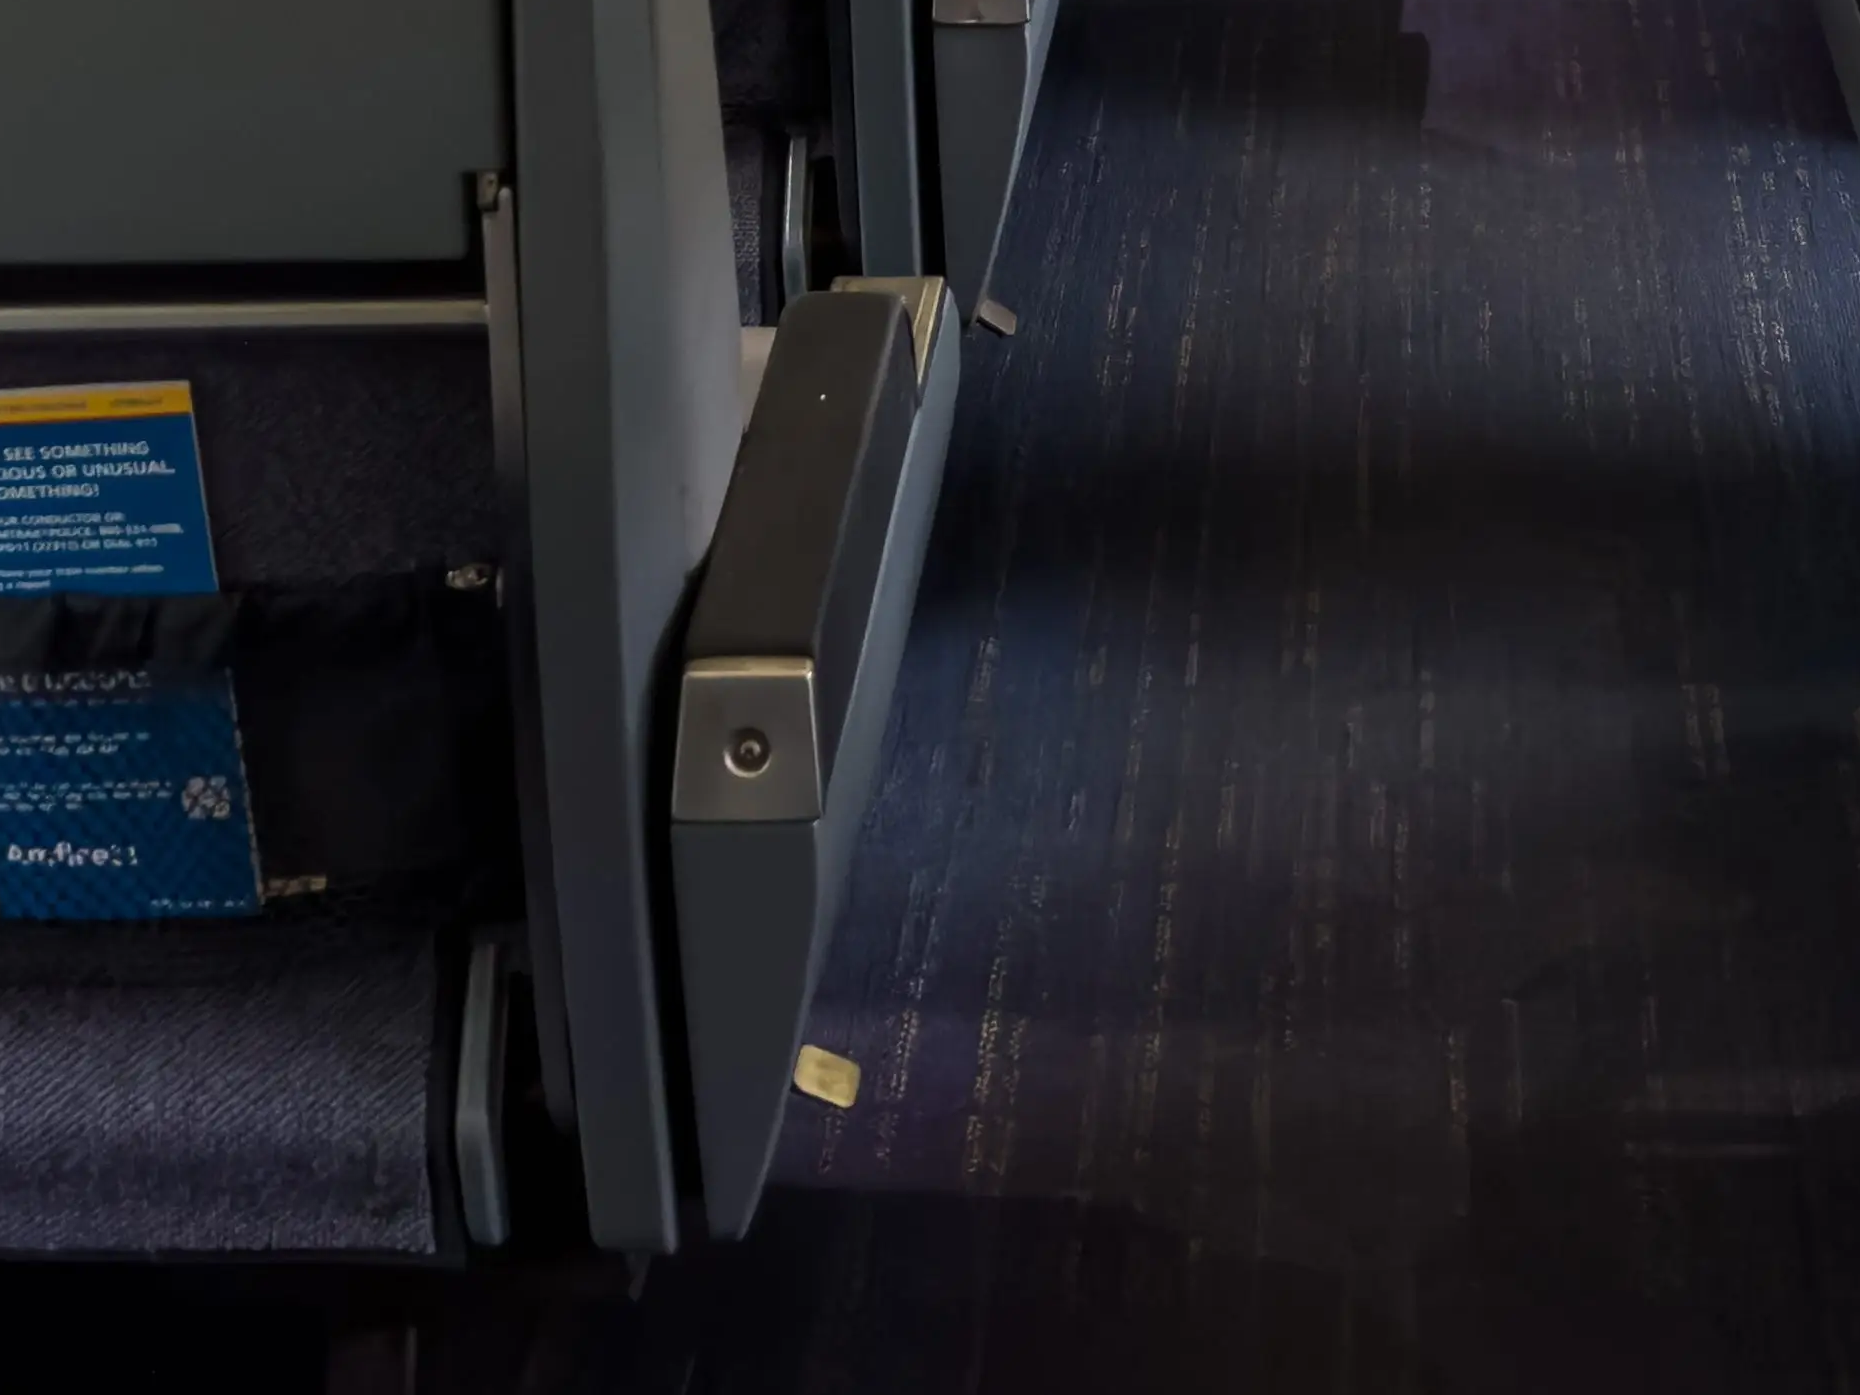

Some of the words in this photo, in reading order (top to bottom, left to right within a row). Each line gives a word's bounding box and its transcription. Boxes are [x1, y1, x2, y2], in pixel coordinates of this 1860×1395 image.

[3, 446, 35, 461] SEE
[38, 441, 150, 460] SOMETHING
[51, 464, 76, 478] OR
